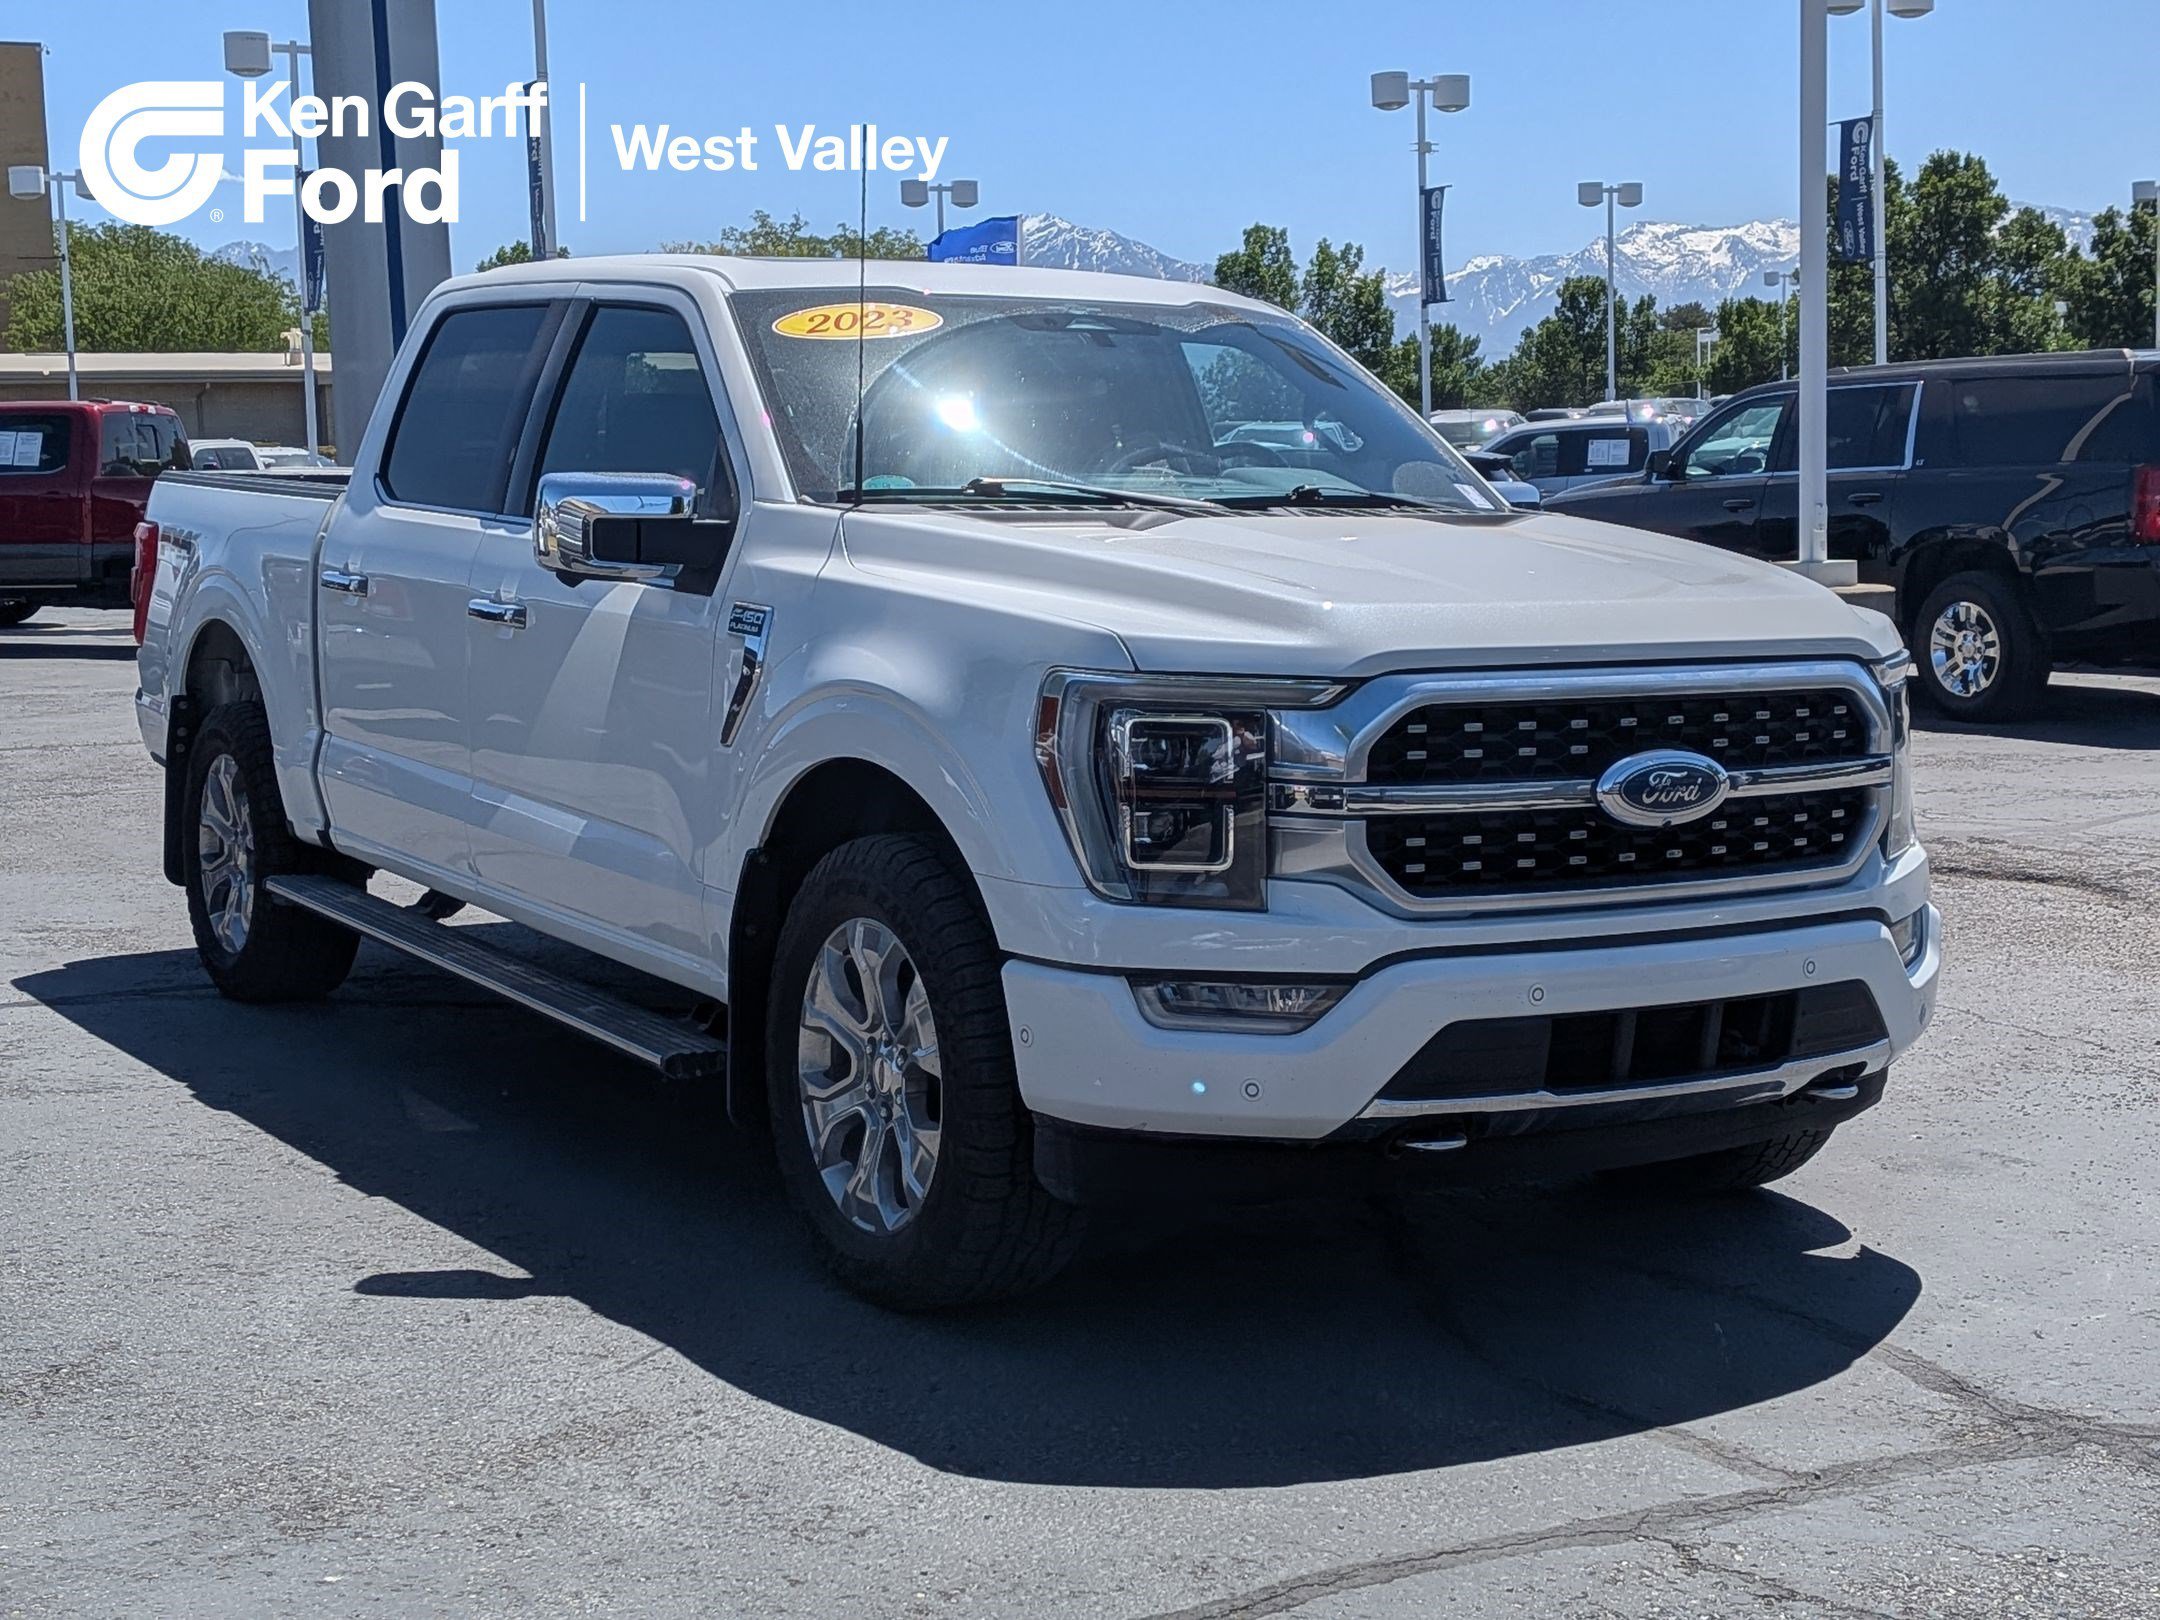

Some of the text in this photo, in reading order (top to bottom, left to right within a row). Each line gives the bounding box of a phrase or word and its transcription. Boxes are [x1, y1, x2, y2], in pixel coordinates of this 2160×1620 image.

[1850, 146, 1859, 182] Ford
[806, 309, 913, 335] 2023
[1641, 770, 1703, 805] Ford
